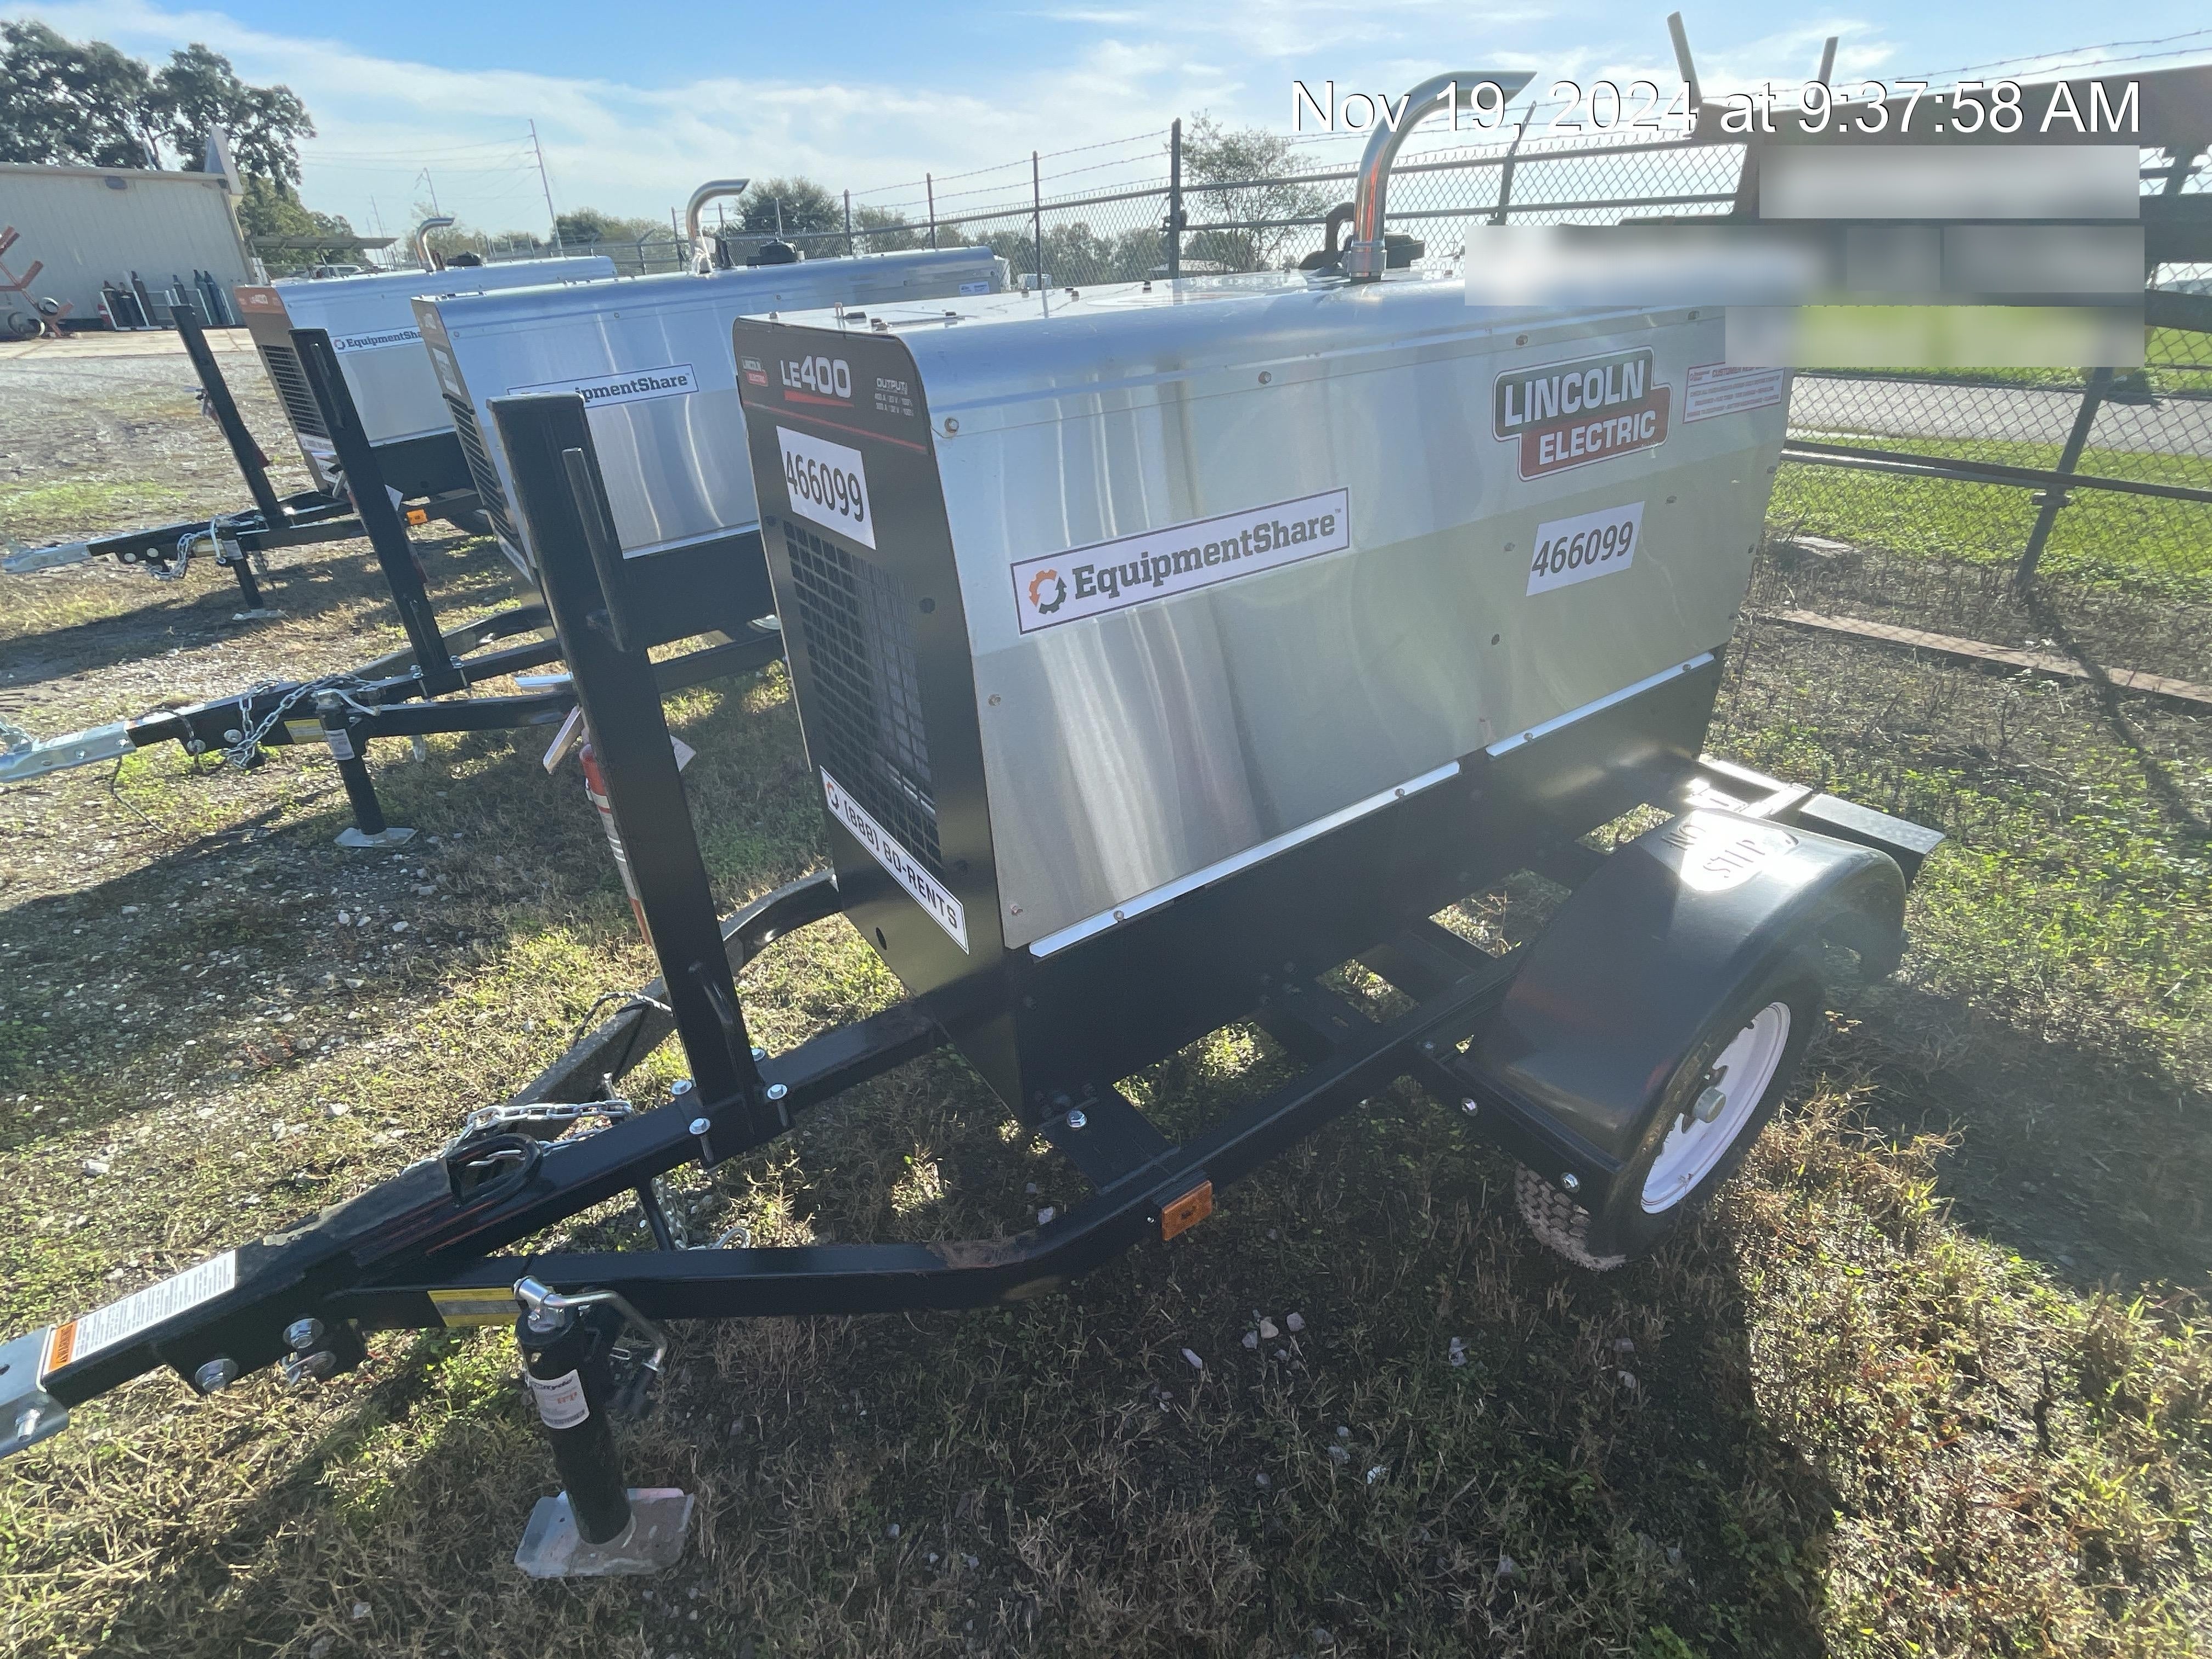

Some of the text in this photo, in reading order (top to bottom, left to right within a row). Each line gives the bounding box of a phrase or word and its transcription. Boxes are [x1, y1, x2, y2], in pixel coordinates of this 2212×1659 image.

[345, 331, 421, 348] EquipmentSha
[575, 375, 688, 403] ipmentShare
[780, 356, 851, 399] LE400
[1505, 359, 1645, 427] LINCOLN
[1539, 410, 1656, 465] ELECTRIC
[787, 451, 864, 522] 466099
[1072, 514, 1336, 599] EquipmentShare
[1531, 521, 1634, 577] 466099
[844, 800, 958, 929] (888) 80-RENTS
